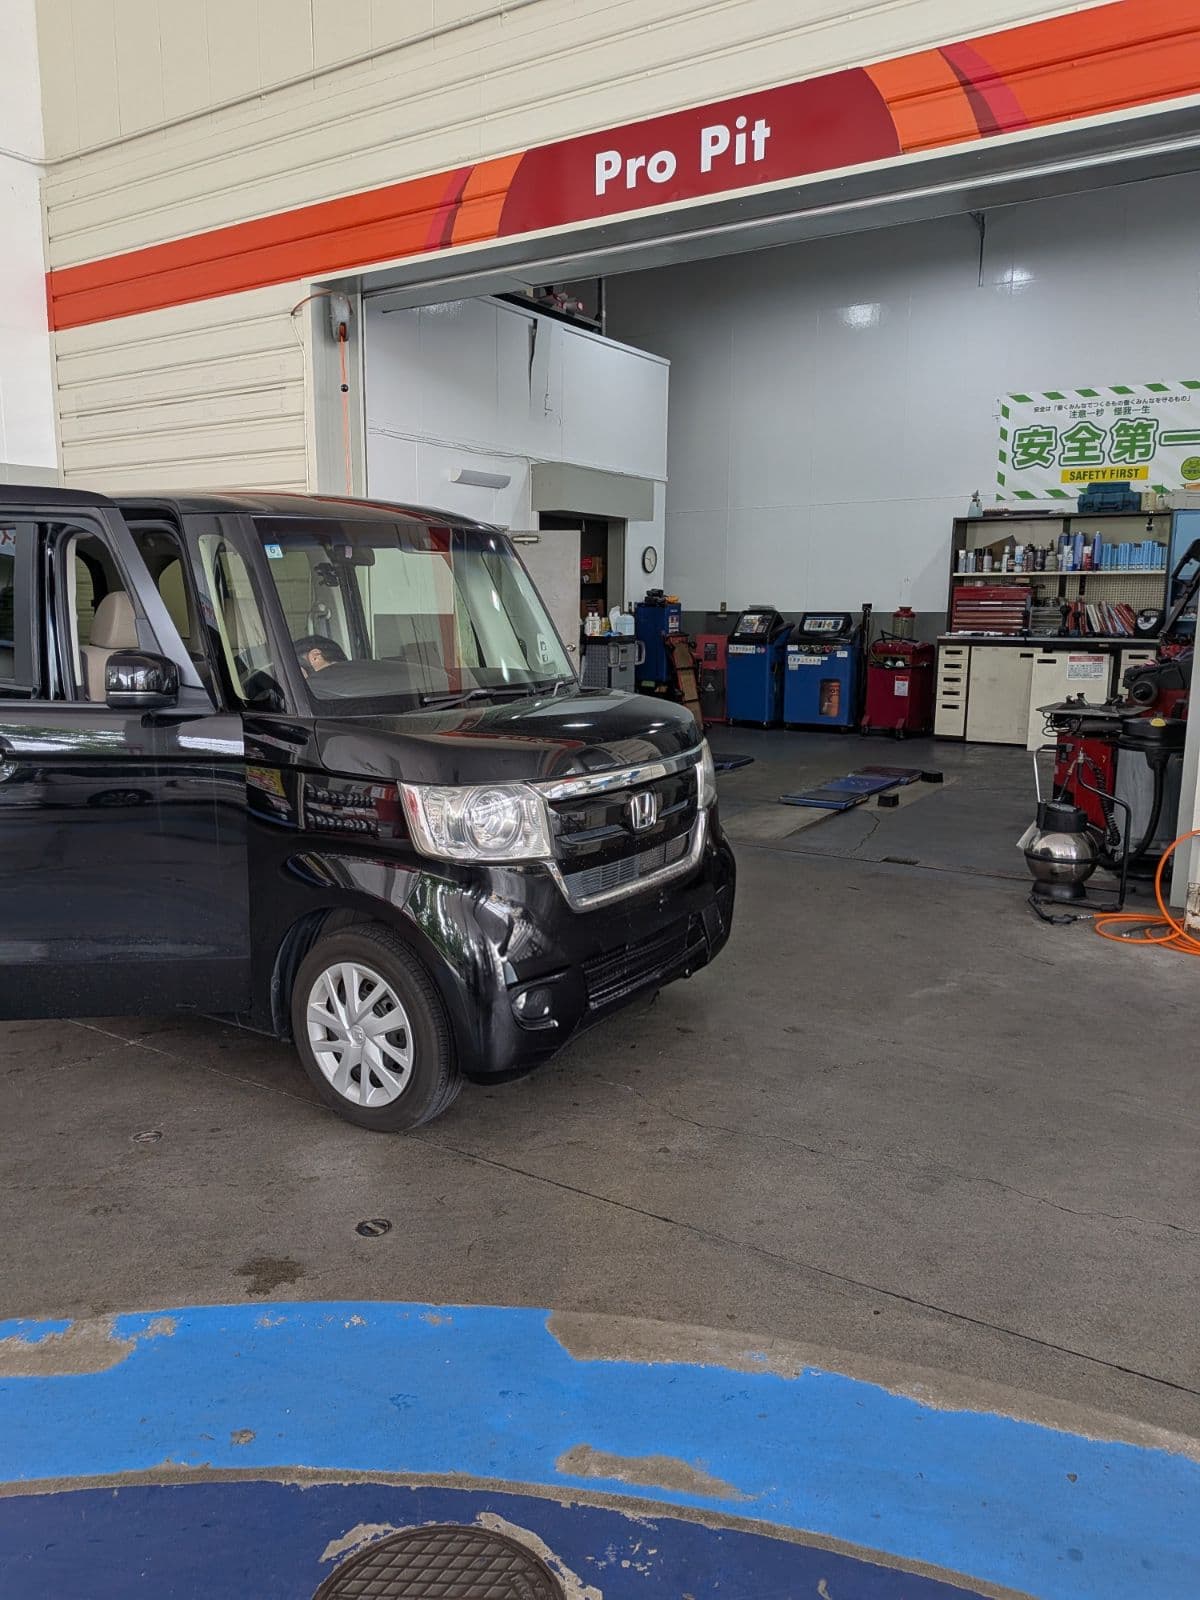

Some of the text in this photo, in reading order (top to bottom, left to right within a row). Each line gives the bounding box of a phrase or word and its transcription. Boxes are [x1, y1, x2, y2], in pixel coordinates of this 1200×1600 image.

[595, 115, 771, 196] Pro Pit
[1069, 405, 1151, 419] 注意一秒 怪我一生
[1013, 419, 1200, 469] 安全第一
[1069, 468, 1140, 481] SAFETY FIRST
